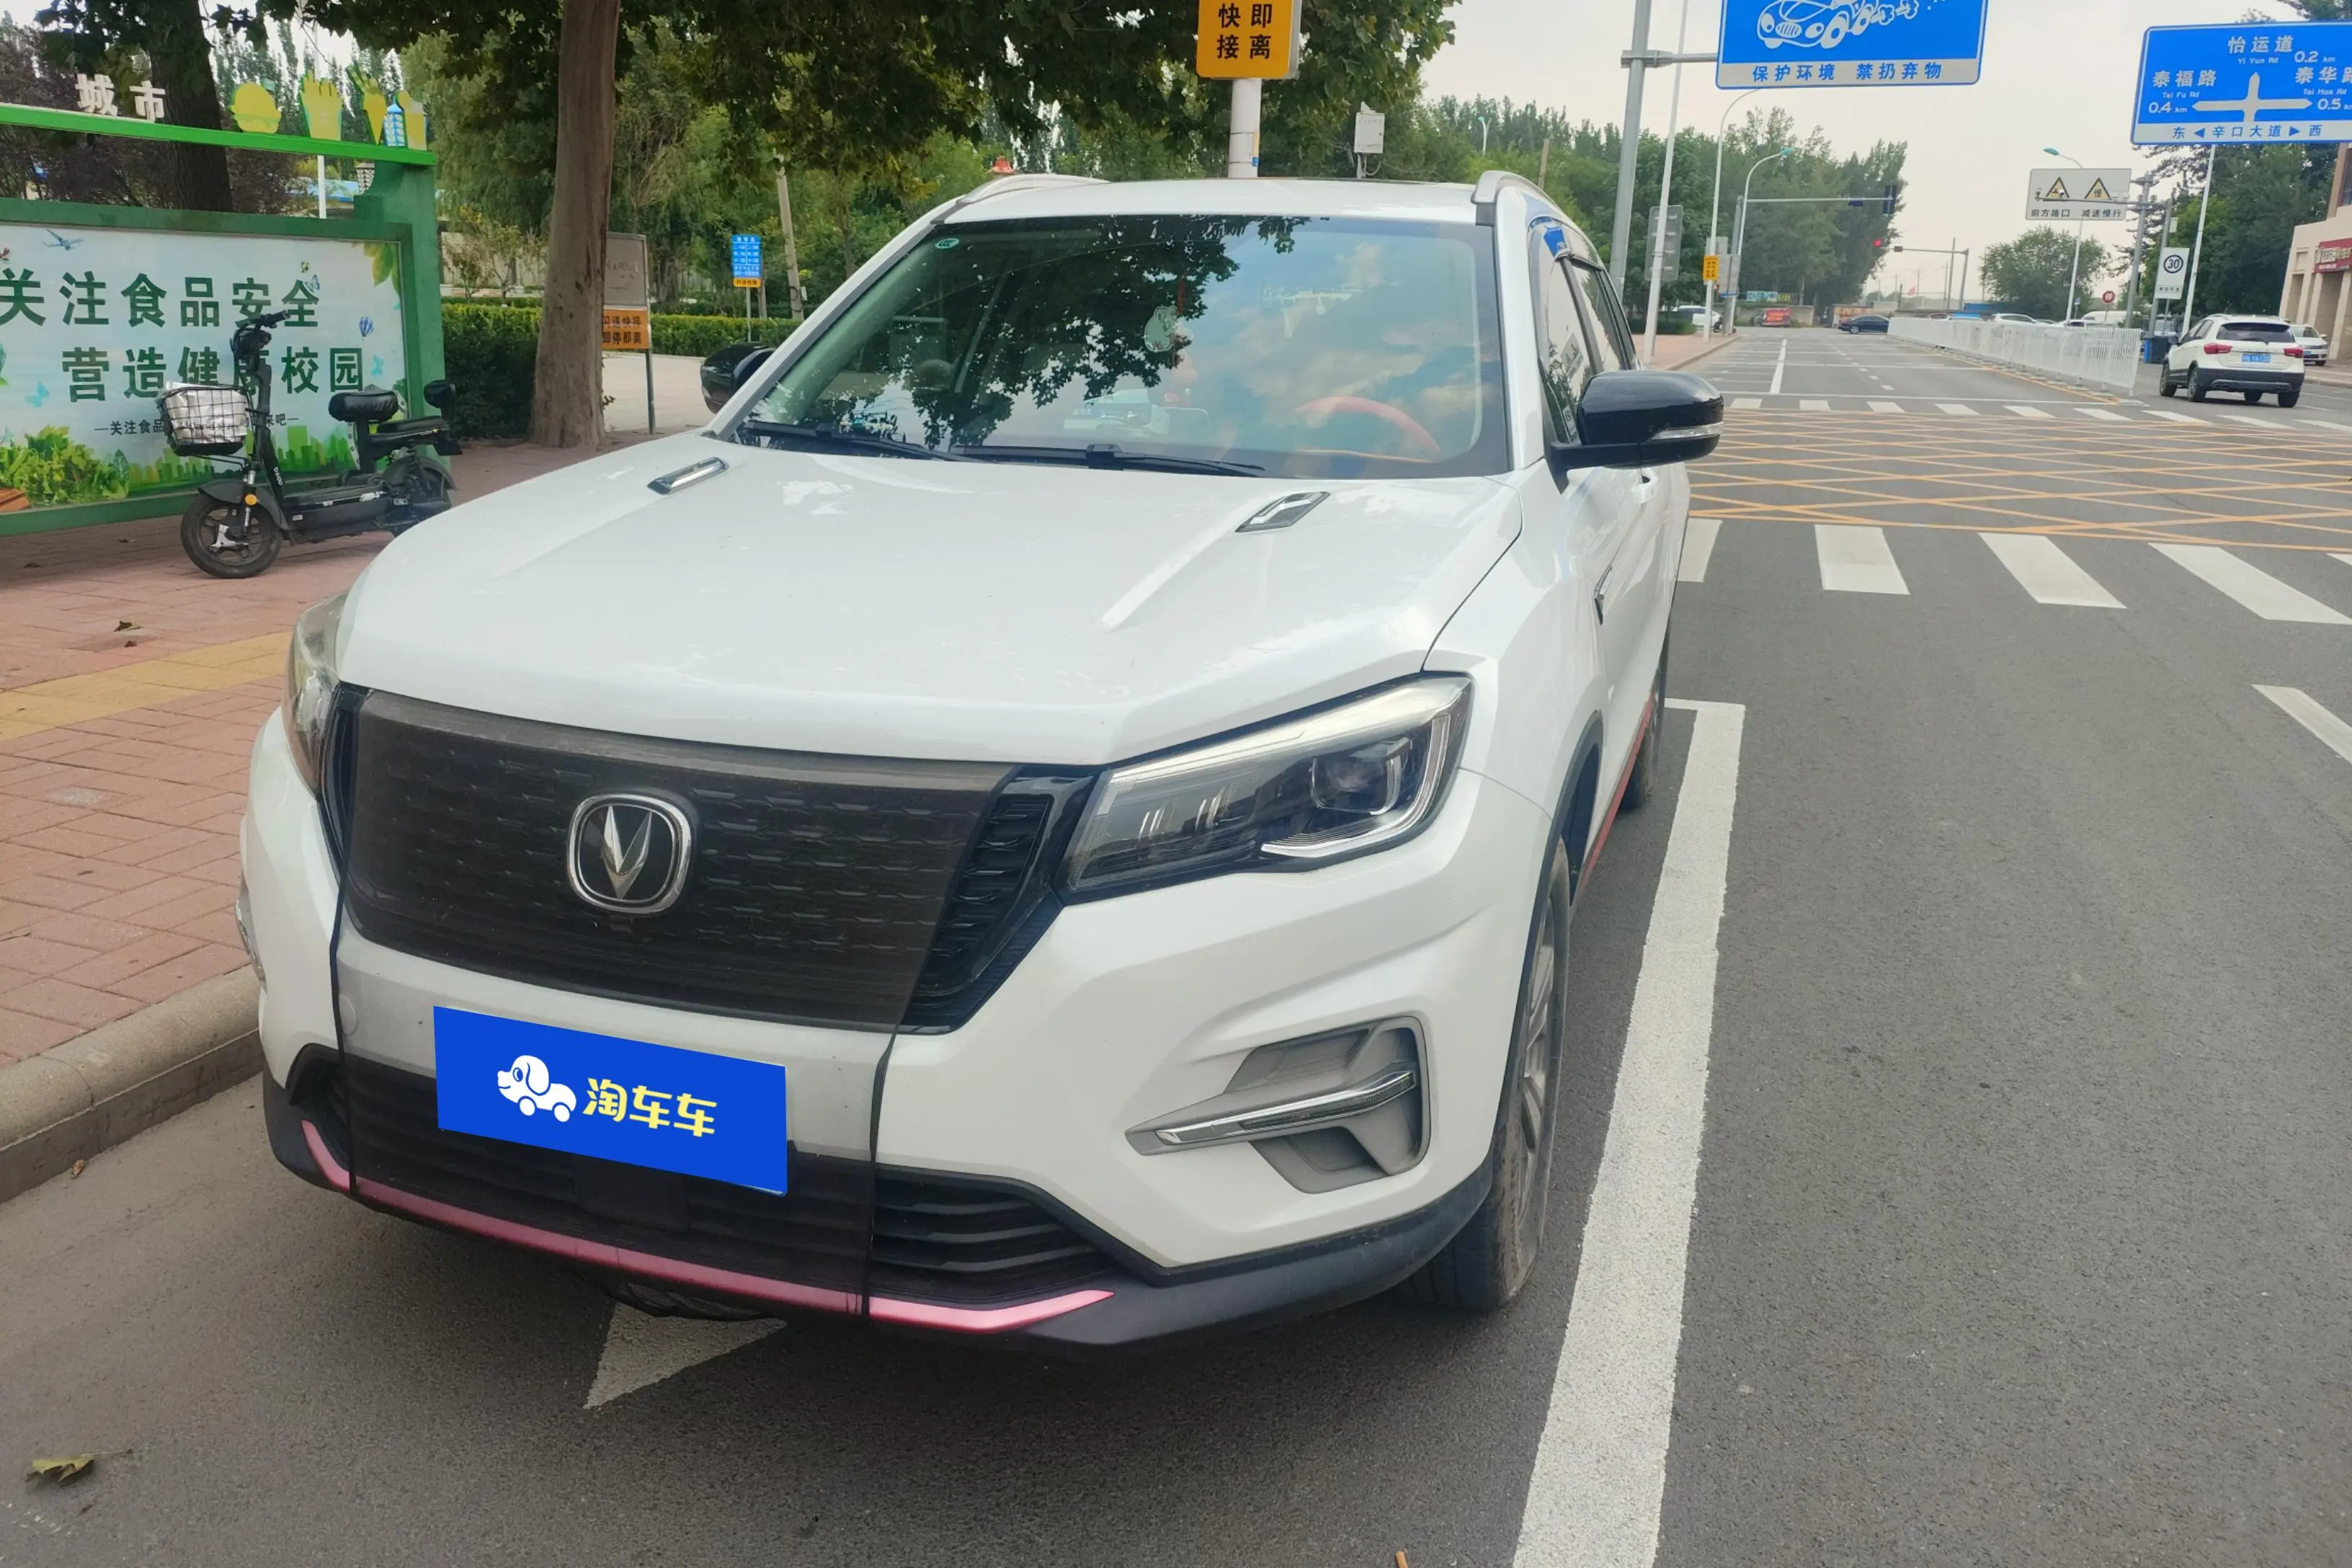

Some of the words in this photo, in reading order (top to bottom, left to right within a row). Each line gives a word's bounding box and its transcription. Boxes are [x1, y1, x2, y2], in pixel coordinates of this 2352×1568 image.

[2228, 35, 2294, 54] 怡运道
[2294, 50, 2319, 63] 0.2
[1752, 63, 1835, 82] 保护环境
[1856, 62, 1941, 81] 禁扔弃物
[2152, 69, 2217, 88] 泰福路
[75, 74, 166, 123] 城市
[2317, 98, 2341, 110] 0.5
[2148, 101, 2172, 113] 0.4
[2173, 126, 2186, 139] 东
[2211, 125, 2281, 138] 辛口大道
[2309, 125, 2322, 137] 西
[2093, 189, 2102, 197] 慢
[2031, 208, 2070, 218] 前方路口
[2082, 209, 2122, 218] 减速慢行
[2167, 259, 2180, 270] 30
[0, 268, 319, 327] 关注食品安全
